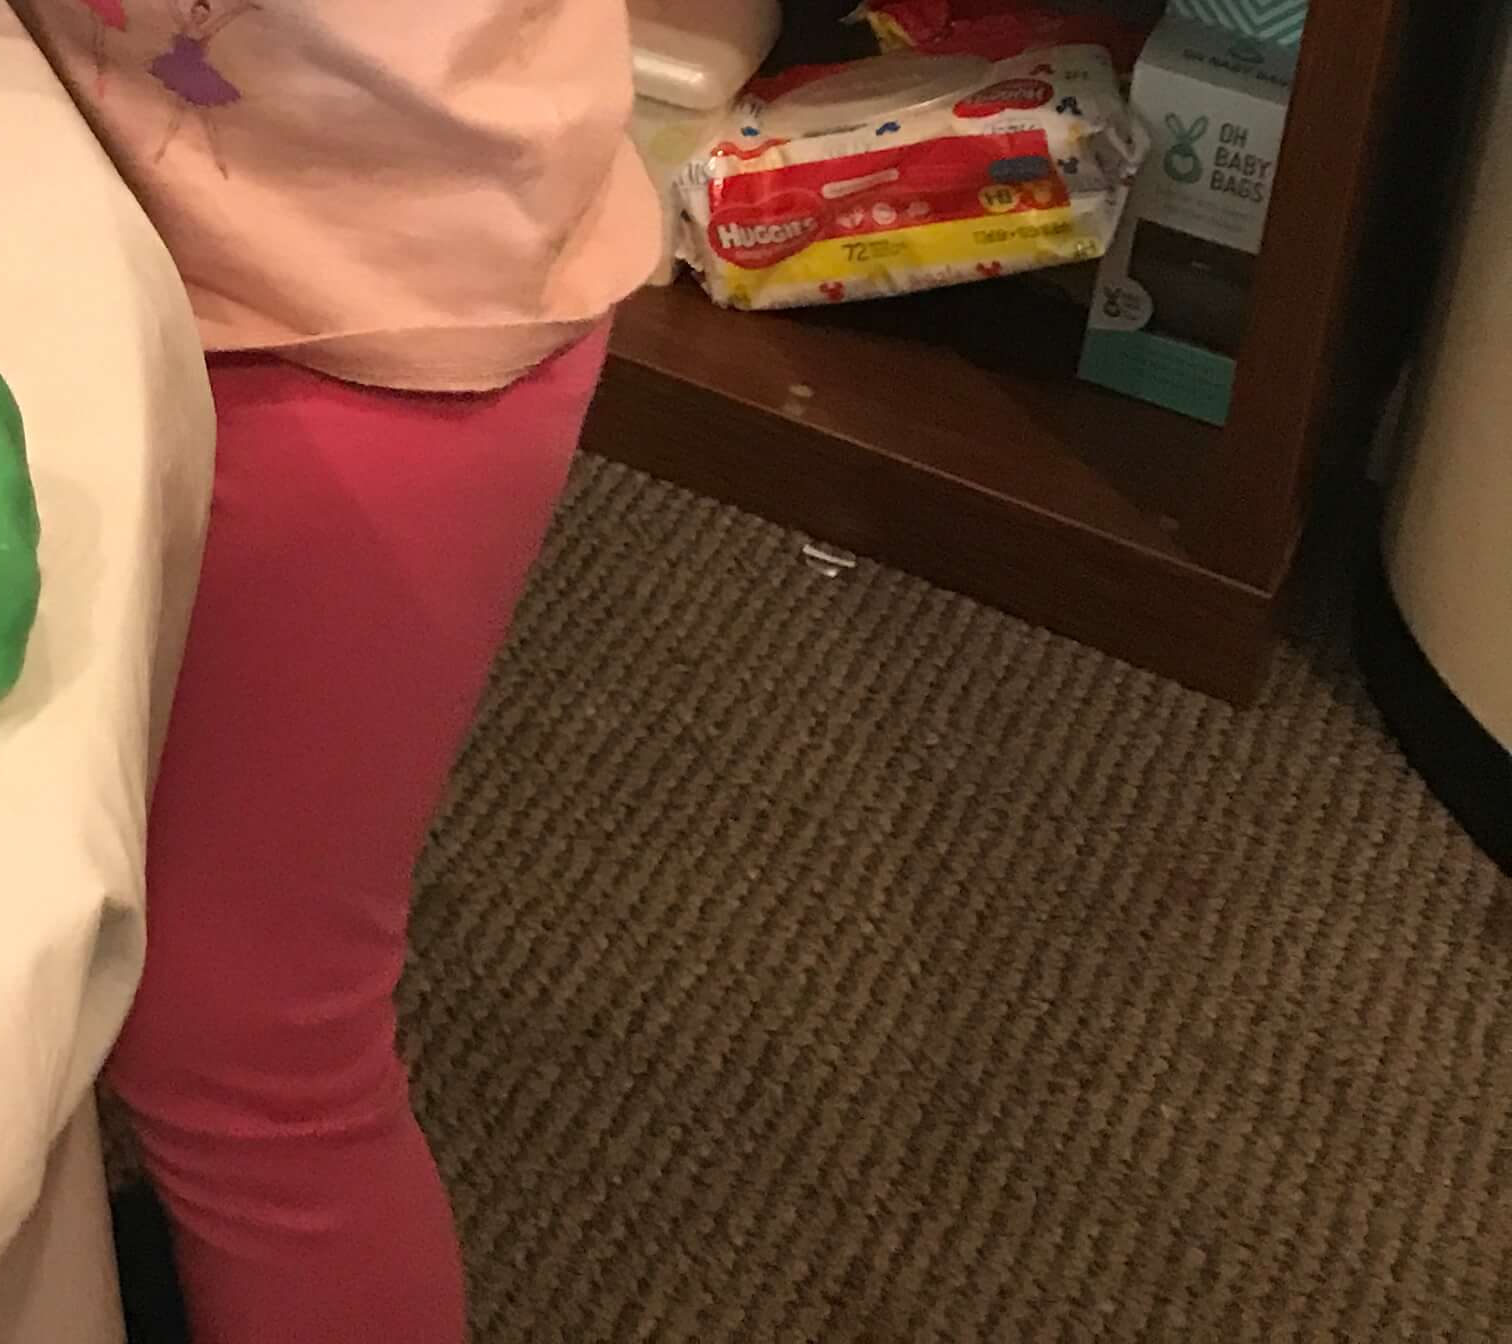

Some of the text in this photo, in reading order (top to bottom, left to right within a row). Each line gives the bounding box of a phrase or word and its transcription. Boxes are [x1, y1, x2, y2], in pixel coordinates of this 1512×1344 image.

[1219, 123, 1248, 148] OH
[1214, 146, 1273, 178] BABY
[1209, 169, 1264, 203] BAGS
[841, 241, 871, 262] 72
